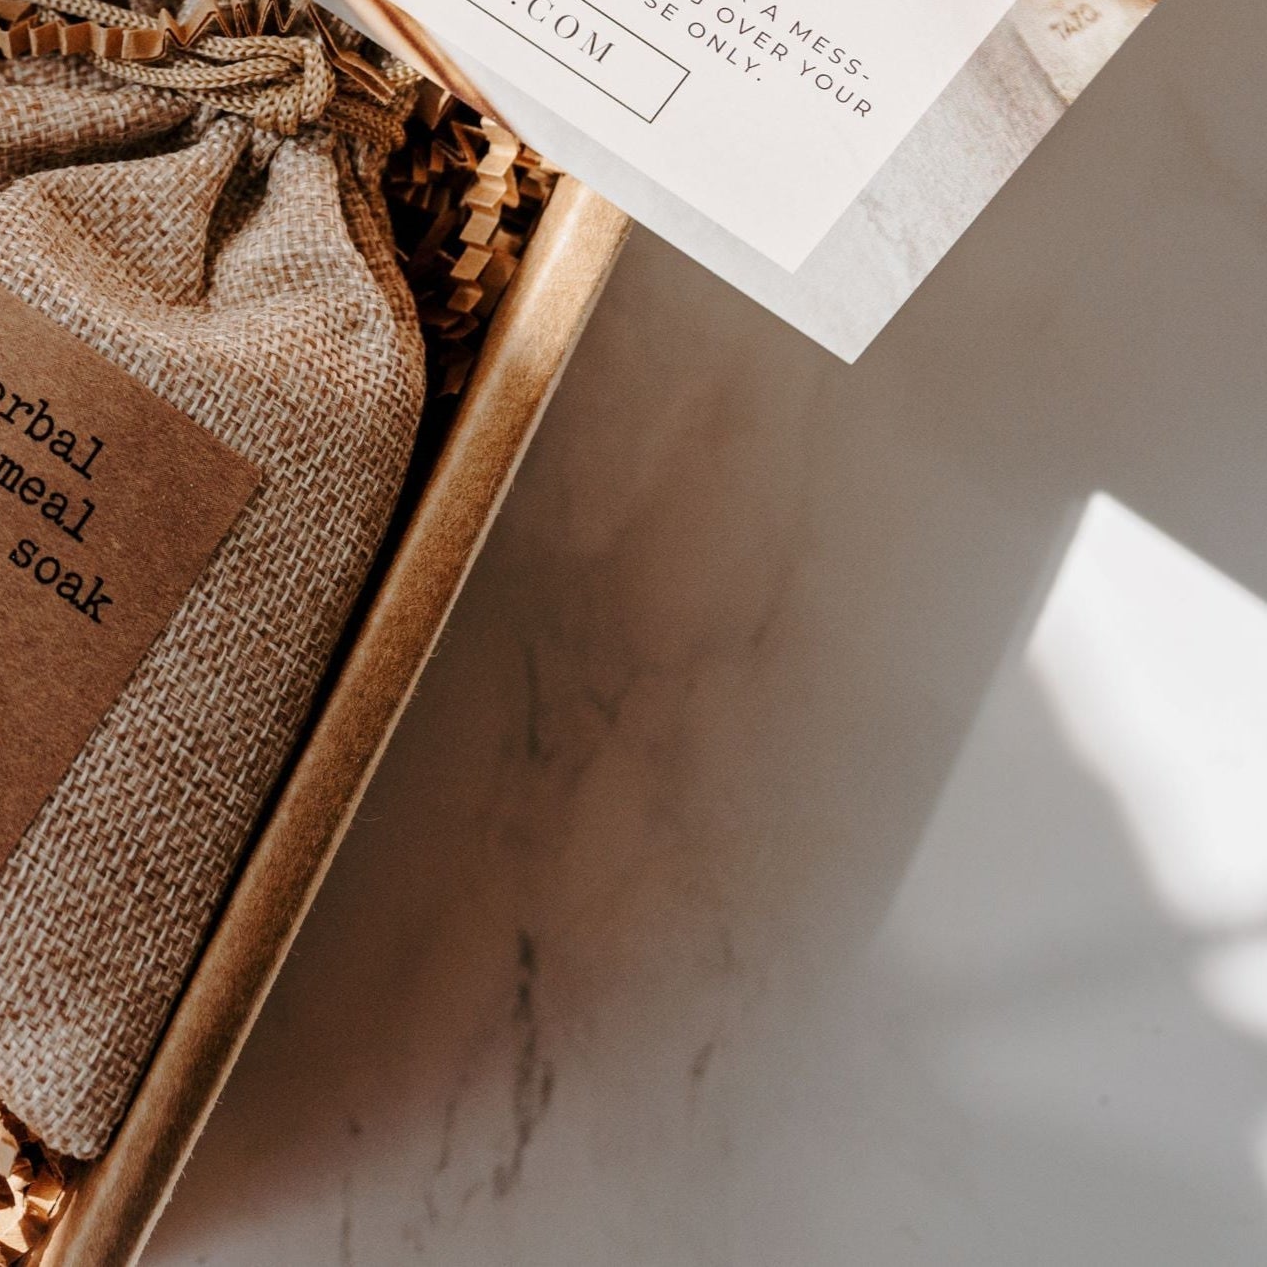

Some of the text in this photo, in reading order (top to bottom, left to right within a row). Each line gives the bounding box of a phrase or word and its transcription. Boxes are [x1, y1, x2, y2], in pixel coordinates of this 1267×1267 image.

[715, 5, 789, 62] OVER
[798, 58, 872, 118] YOUR
[758, 3, 778, 23] A
[787, 19, 870, 80] MESS-
[6, 537, 114, 625] soak
